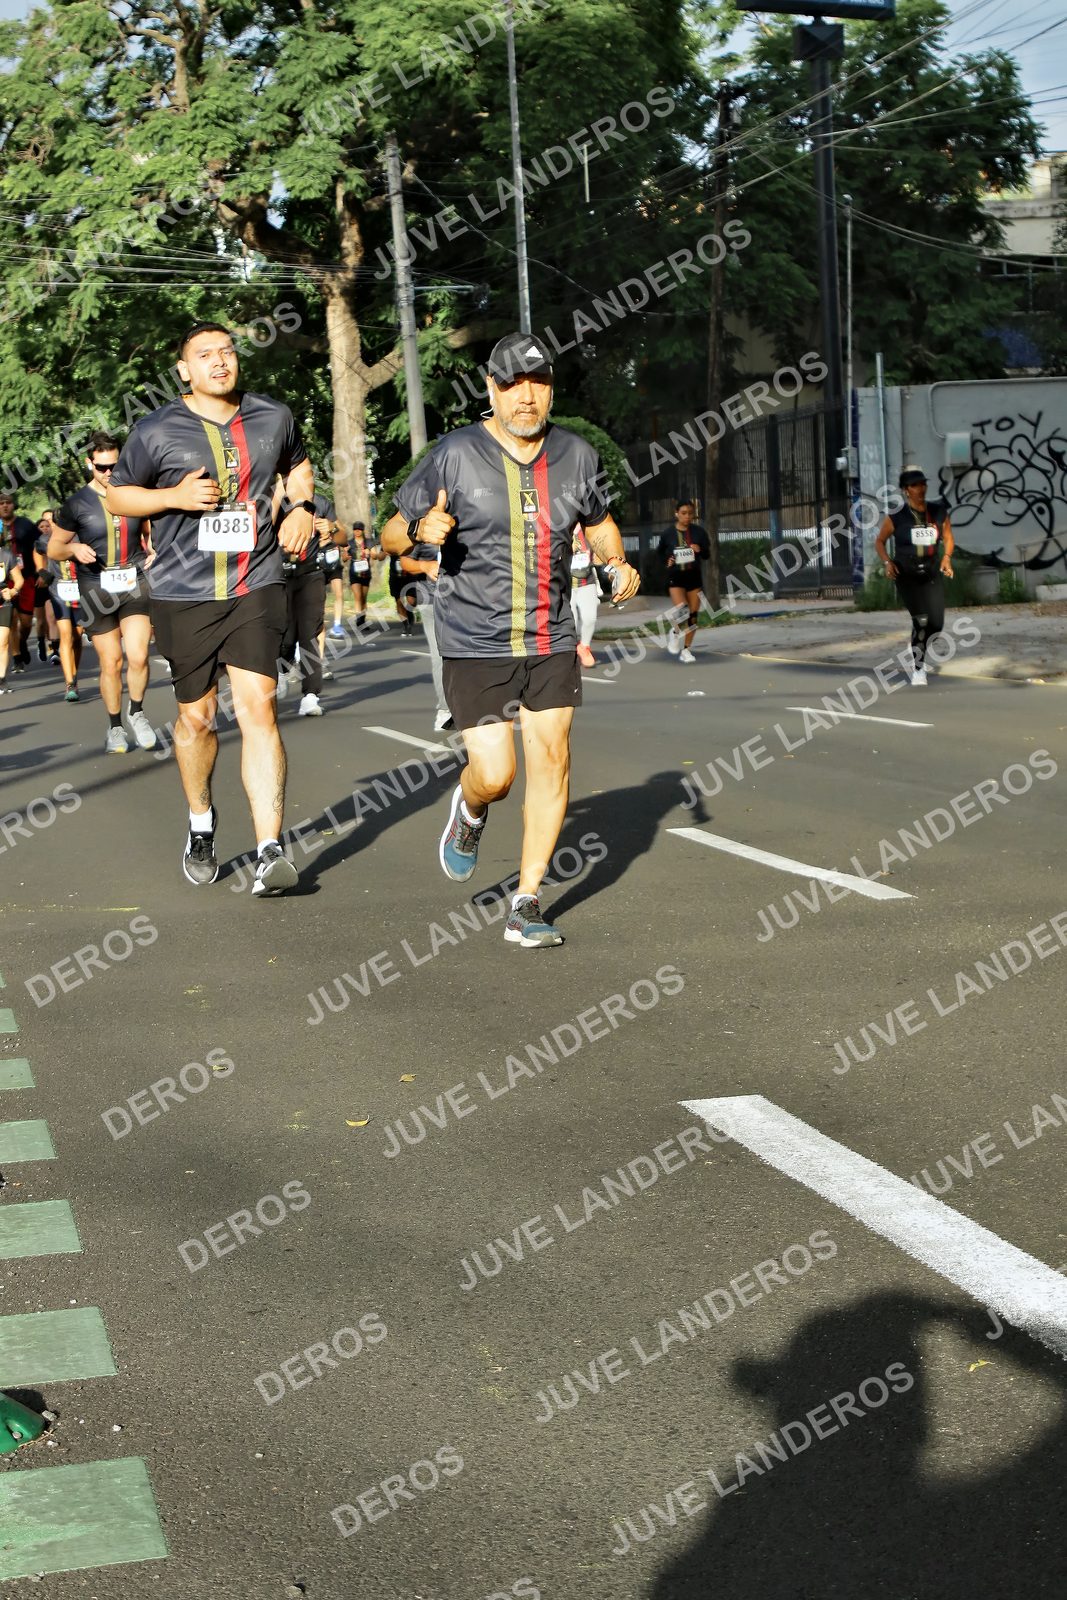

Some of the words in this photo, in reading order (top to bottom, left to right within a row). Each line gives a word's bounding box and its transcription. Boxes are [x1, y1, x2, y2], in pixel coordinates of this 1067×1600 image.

[972, 411, 1042, 439] TOY
[203, 518, 250, 533] 10385
[111, 573, 128, 582] 145
